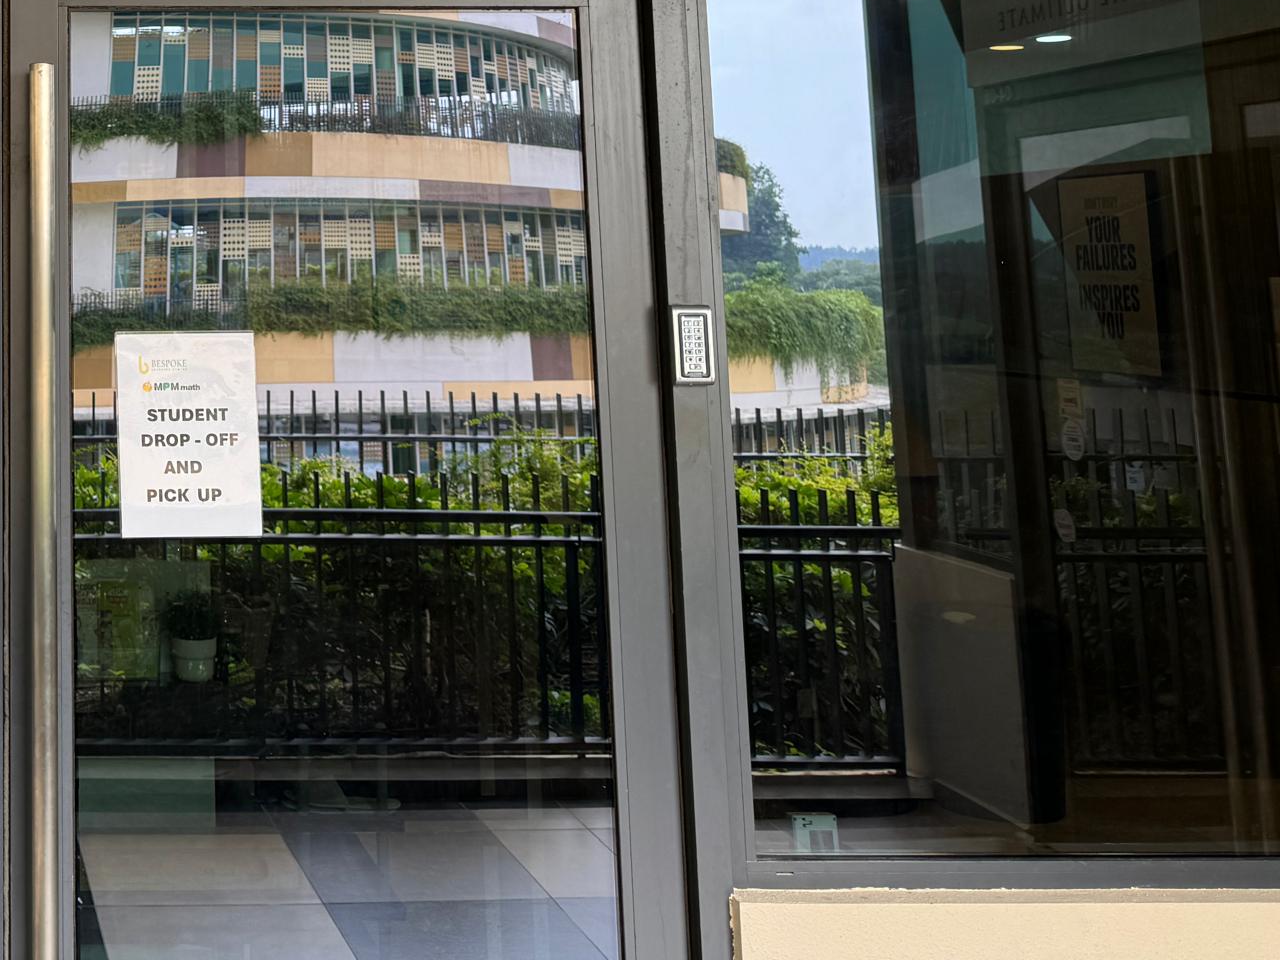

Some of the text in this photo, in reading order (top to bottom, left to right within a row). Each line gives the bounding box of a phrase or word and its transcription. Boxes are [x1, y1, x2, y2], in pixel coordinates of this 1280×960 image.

[1086, 216, 1120, 244] YOUR
[1076, 244, 1137, 272] FAILURES
[1079, 284, 1141, 313] INSPIRES
[1097, 311, 1125, 340] YOU
[152, 360, 188, 368] BESPOKE
[154, 382, 180, 391] MPM
[147, 408, 229, 422] STUDENT
[141, 433, 239, 447] DROP OFF
[164, 461, 203, 474] AND
[147, 488, 223, 502] PICK UP
